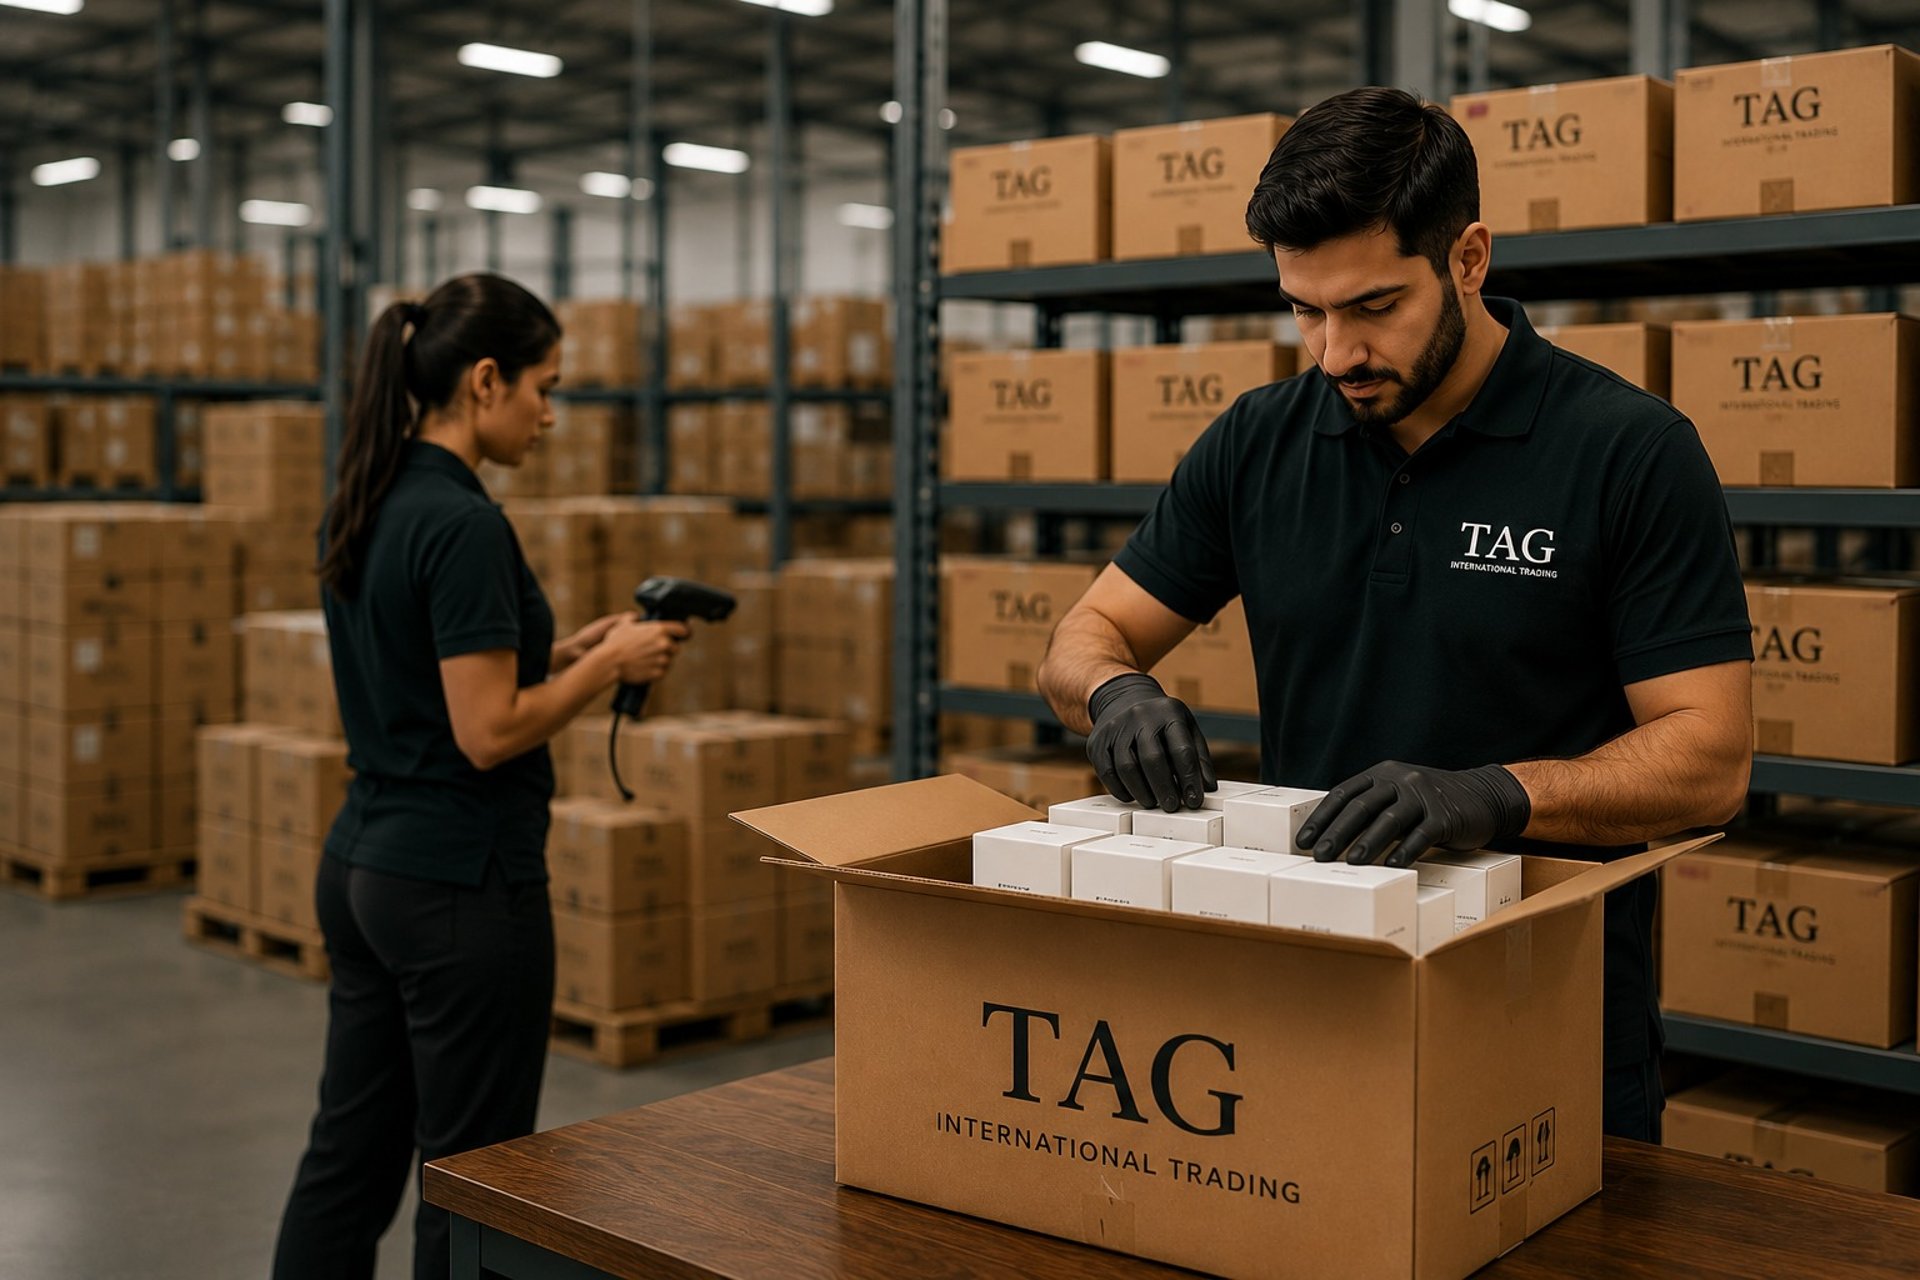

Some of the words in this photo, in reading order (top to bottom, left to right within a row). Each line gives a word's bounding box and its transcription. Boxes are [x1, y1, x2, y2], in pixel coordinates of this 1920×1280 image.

[1733, 86, 1821, 128] TAG
[1502, 113, 1582, 152] TAG
[991, 167, 1051, 199] TAG
[1158, 149, 1224, 182] TAG
[1157, 373, 1224, 407] TAG
[1732, 354, 1823, 392] TAG
[991, 379, 1051, 410] TAG
[1460, 522, 1555, 564] TAG
[1450, 561, 1517, 575] INTERNATIONAL
[1519, 567, 1558, 579] TRADING
[992, 590, 1050, 622] TAG
[1752, 624, 1823, 664] AG
[1727, 897, 1818, 944] TAG
[981, 1001, 1244, 1137] TAG
[936, 1112, 1157, 1176] INTERNATIONAL
[1168, 1158, 1301, 1205] TRADING
